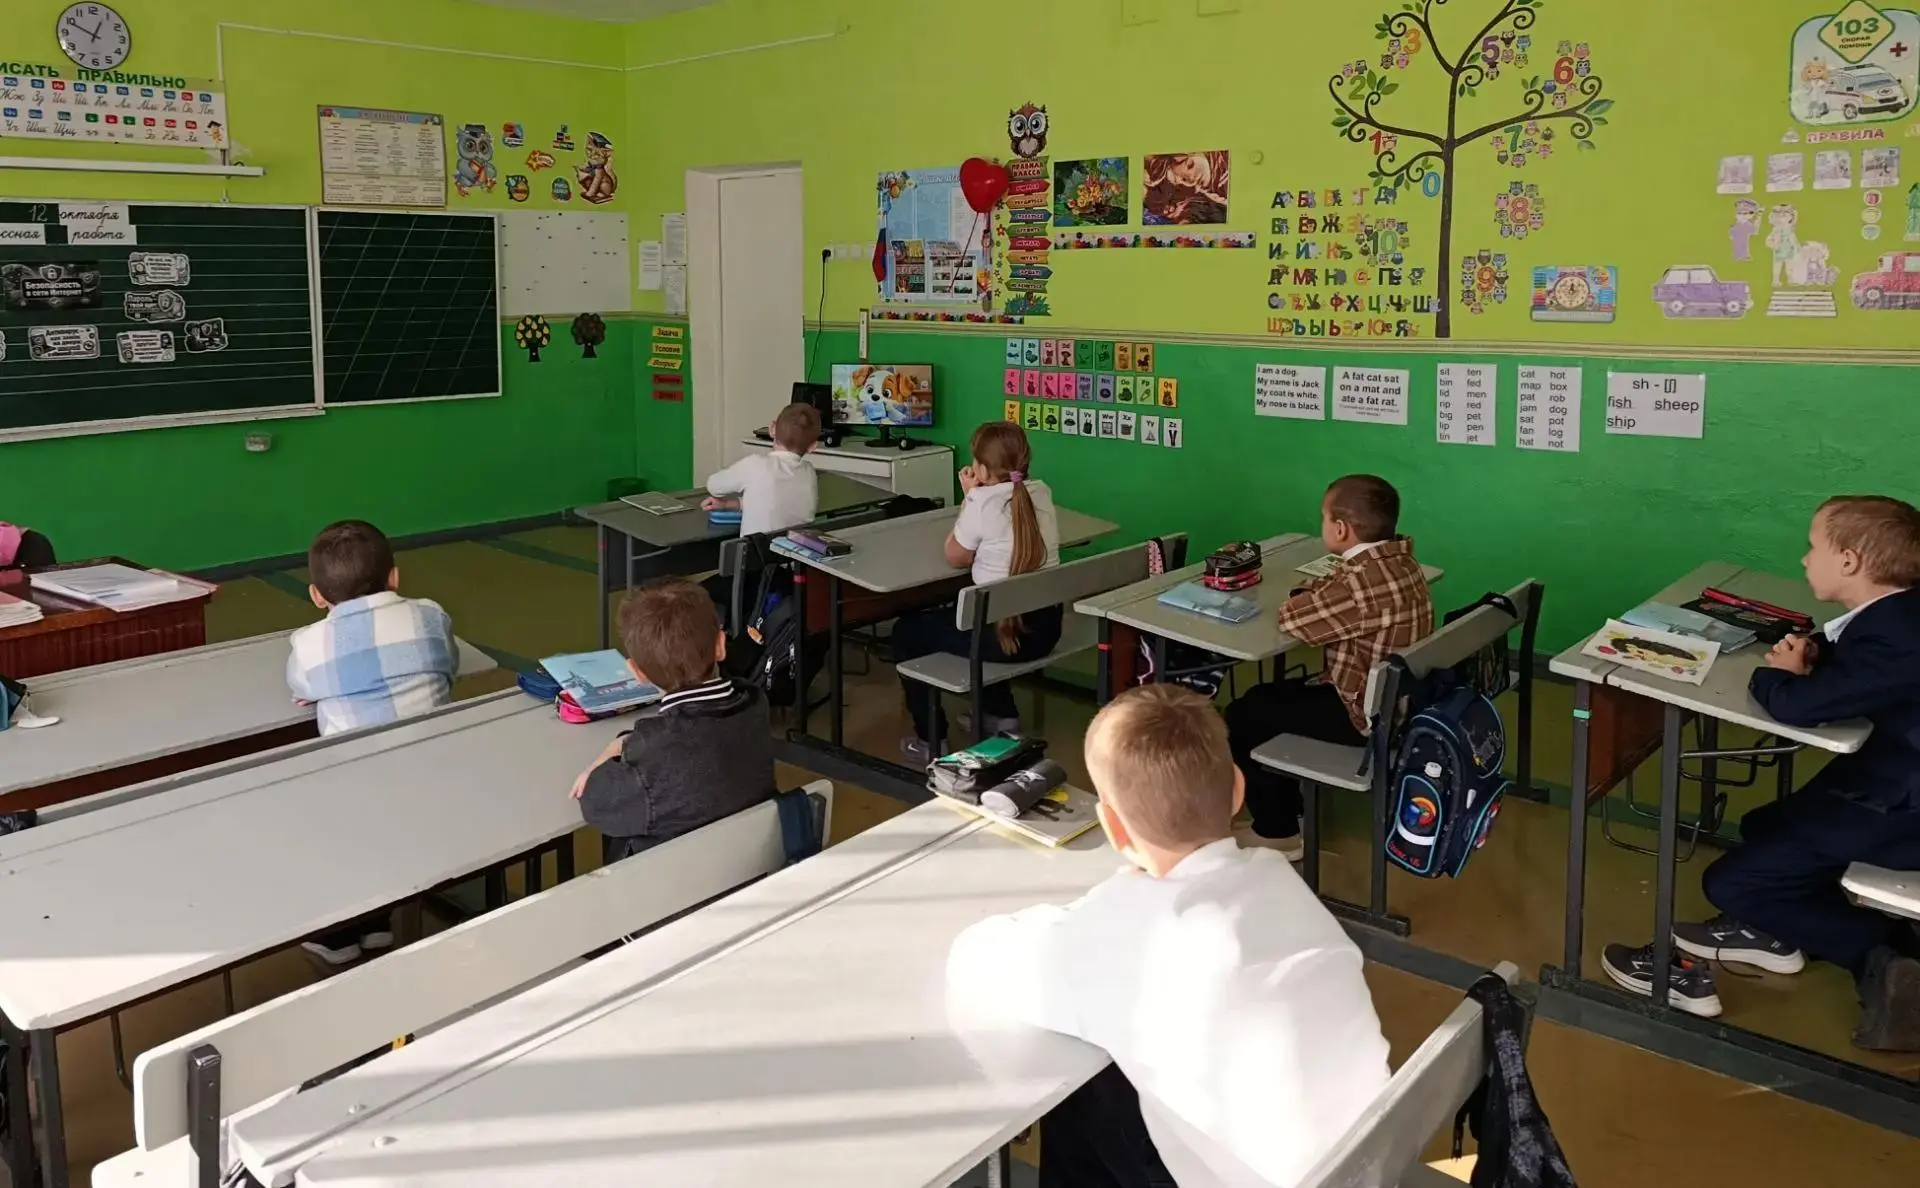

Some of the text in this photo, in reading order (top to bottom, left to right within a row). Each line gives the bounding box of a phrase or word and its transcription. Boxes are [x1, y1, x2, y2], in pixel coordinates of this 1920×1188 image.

[76, 8, 83, 18] 11
[88, 6, 99, 15] 12
[106, 12, 110, 21] 1
[66, 17, 76, 26] 10
[113, 23, 121, 32] 2
[1834, 17, 1880, 36] 103
[61, 28, 69, 36] 9
[119, 36, 126, 44] 3
[1404, 28, 1421, 54] 3
[114, 48, 122, 56] 4
[1481, 35, 1500, 62] 5
[78, 53, 86, 61] 7
[105, 56, 113, 64] 5
[91, 58, 100, 66] 6
[1554, 56, 1575, 84] 6
[77, 68, 186, 89] ПРАВИЛЬНО
[1348, 76, 1366, 100] 2
[1504, 124, 1523, 153] 7
[1807, 128, 1884, 142] ПРАВИЛА
[1369, 130, 1382, 155] 1
[1011, 161, 1044, 170] ПРАВИЛА
[1422, 171, 1441, 197] 0
[1271, 191, 1288, 209] А
[29, 204, 120, 225] 12 октября
[1509, 197, 1530, 224] 8
[1321, 215, 1342, 233] Ж
[71, 225, 125, 244] работа
[1367, 230, 1398, 256] 10
[1269, 242, 1283, 260] И
[1296, 238, 1311, 260] Й
[1476, 266, 1497, 292] 9
[25, 281, 81, 290] Безопасность
[50, 289, 82, 297] Интернет
[1330, 293, 1346, 312] Ф
[1346, 295, 1360, 312] Х
[1368, 295, 1381, 314] Ц
[1390, 295, 1402, 313] Ч
[1413, 295, 1431, 313] Ш
[1292, 318, 1306, 335] Ъ
[1310, 319, 1325, 336] Ы
[1329, 319, 1341, 336] Ь
[656, 327, 679, 338] Задача
[654, 344, 681, 354] Условие
[652, 359, 677, 369] Вопрос
[1440, 368, 1450, 376] sit
[1467, 368, 1482, 376] ten
[1520, 370, 1535, 379] cat
[1550, 371, 1566, 380] hot
[1342, 371, 1399, 383] A fat cat sat
[1164, 381, 1172, 389] Qq
[1257, 377, 1268, 386] My
[1292, 379, 1299, 387] is
[1467, 378, 1482, 387] fed
[1520, 382, 1541, 391] map
[1550, 382, 1568, 391] box
[1632, 378, 1649, 390] sh
[1256, 388, 1268, 397] My
[1362, 386, 1380, 394] mat
[1382, 386, 1401, 395] and
[1439, 389, 1450, 397] lid
[1341, 395, 1356, 403] ate
[1366, 396, 1379, 405] fat
[1381, 398, 1398, 406] rat.
[1520, 393, 1535, 401] pat
[1549, 394, 1566, 403] rob
[1256, 399, 1267, 408] My
[1298, 402, 1321, 411] black.
[1519, 404, 1537, 413] jam
[1608, 396, 1700, 414] fish sheep
[1549, 405, 1568, 416] dog
[1439, 411, 1453, 420] big
[1467, 413, 1481, 421] pet
[1519, 415, 1535, 424] sat
[1439, 421, 1450, 431] lip
[1548, 417, 1565, 426] pot
[1607, 415, 1636, 430] ship
[1467, 424, 1484, 432] pen
[1519, 426, 1535, 435] fan
[1548, 428, 1564, 438] log
[1466, 434, 1479, 443] jet
[1519, 437, 1534, 447] hat
[1548, 440, 1565, 448] not
